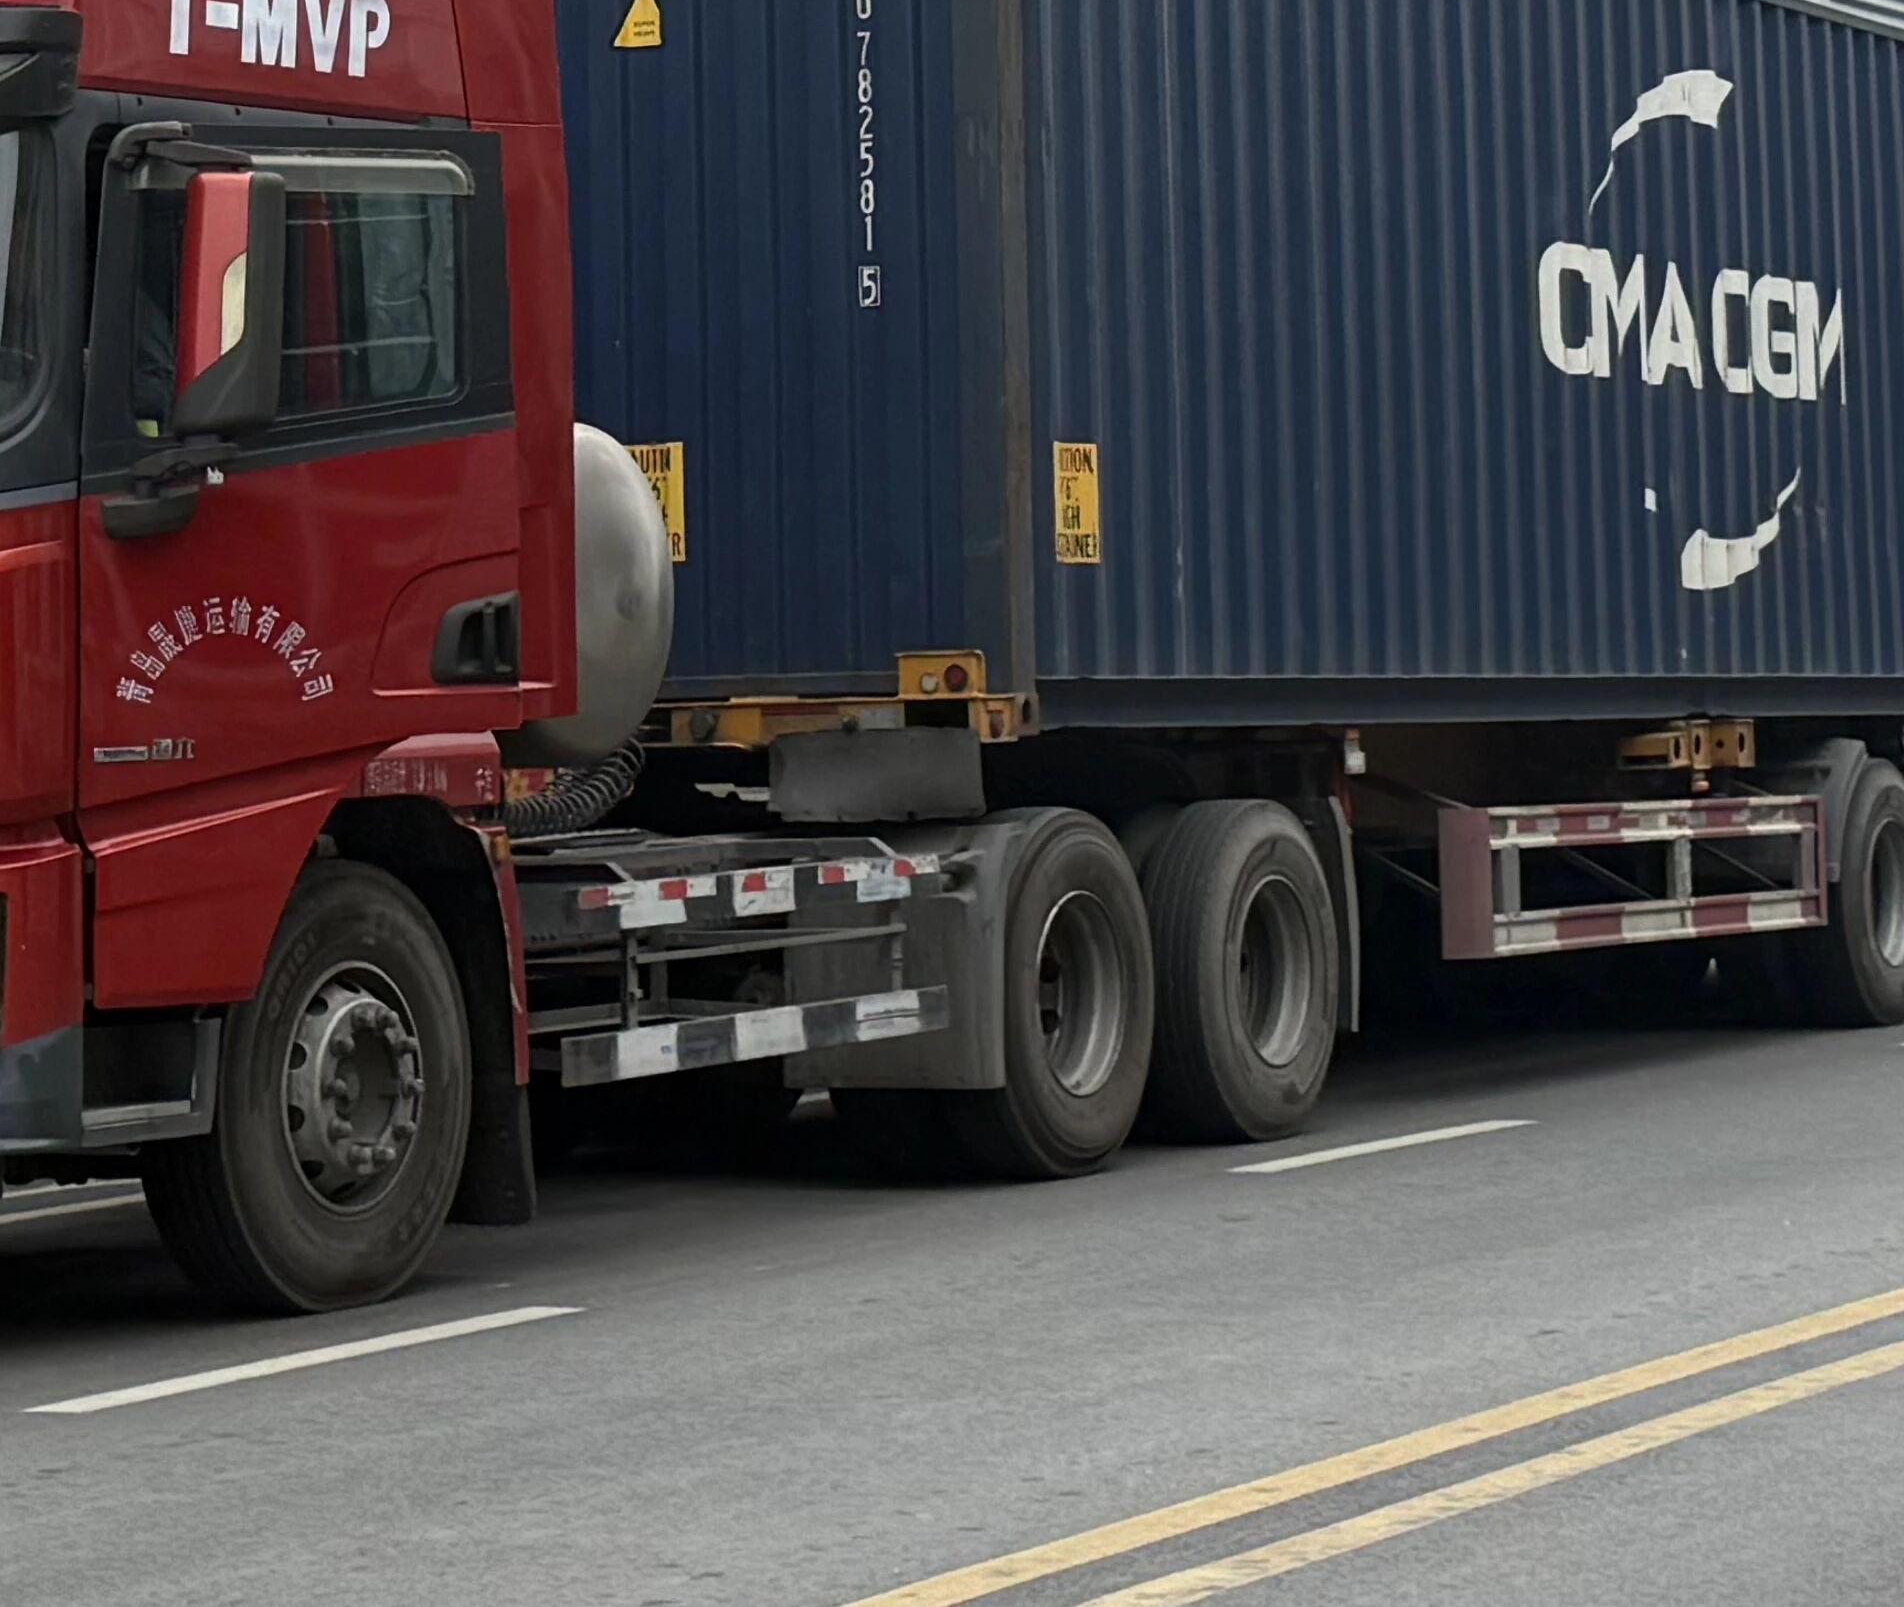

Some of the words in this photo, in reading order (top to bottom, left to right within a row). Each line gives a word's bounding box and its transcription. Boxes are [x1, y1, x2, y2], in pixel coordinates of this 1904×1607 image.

[855, 30, 876, 254] 782581
[1538, 240, 1703, 389] CMA
[1710, 269, 1849, 407] CGM
